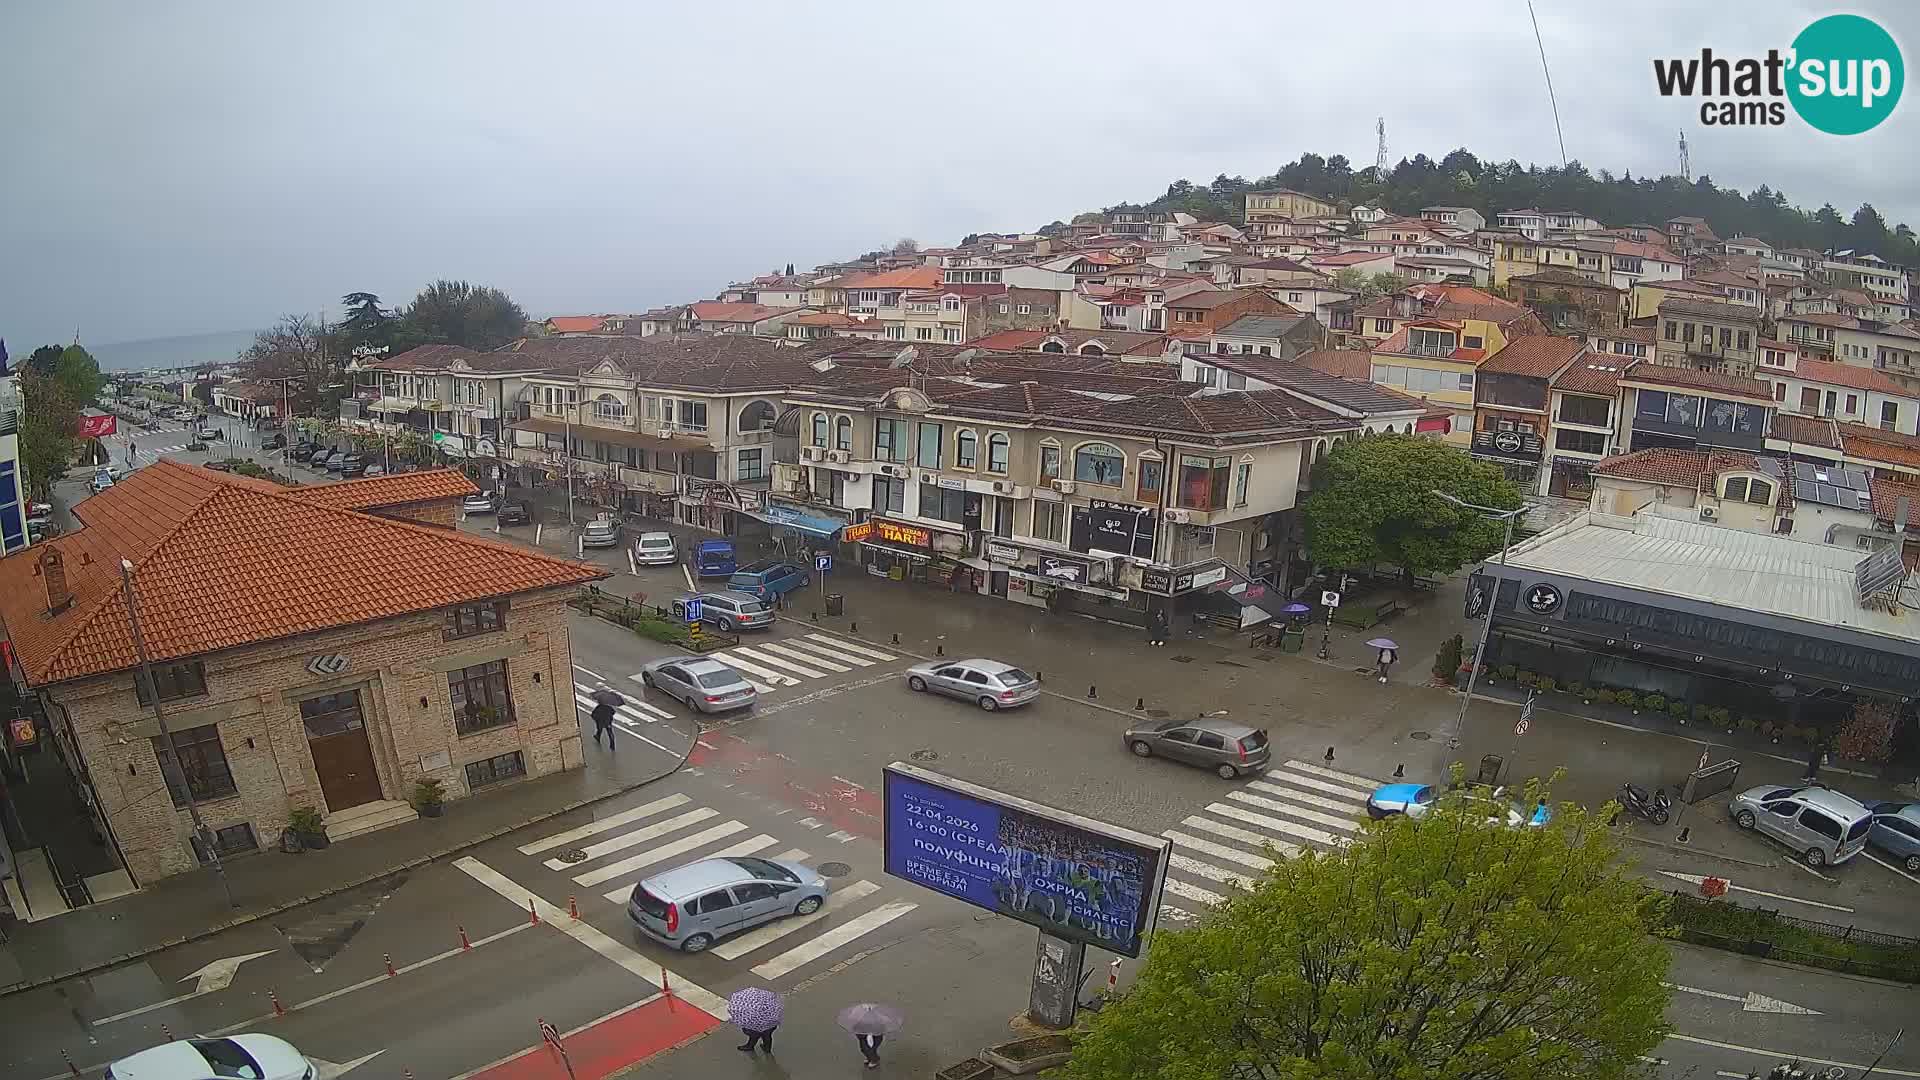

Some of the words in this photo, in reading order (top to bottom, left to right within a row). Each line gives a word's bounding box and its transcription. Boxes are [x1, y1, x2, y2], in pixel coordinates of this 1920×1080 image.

[820, 558, 828, 567] P
[905, 802, 980, 833] 22.04.2026
[907, 817, 948, 837] 16:00
[914, 838, 1022, 880] полуфинале
[906, 859, 943, 877] ВРЕМЕ
[944, 866, 951, 880] Е
[953, 872, 968, 886] ЗА
[906, 866, 968, 892] ИСТОРИЈА!
[1035, 877, 1087, 902] ОХРИД
[1074, 904, 1130, 928] СИЛЕКС
